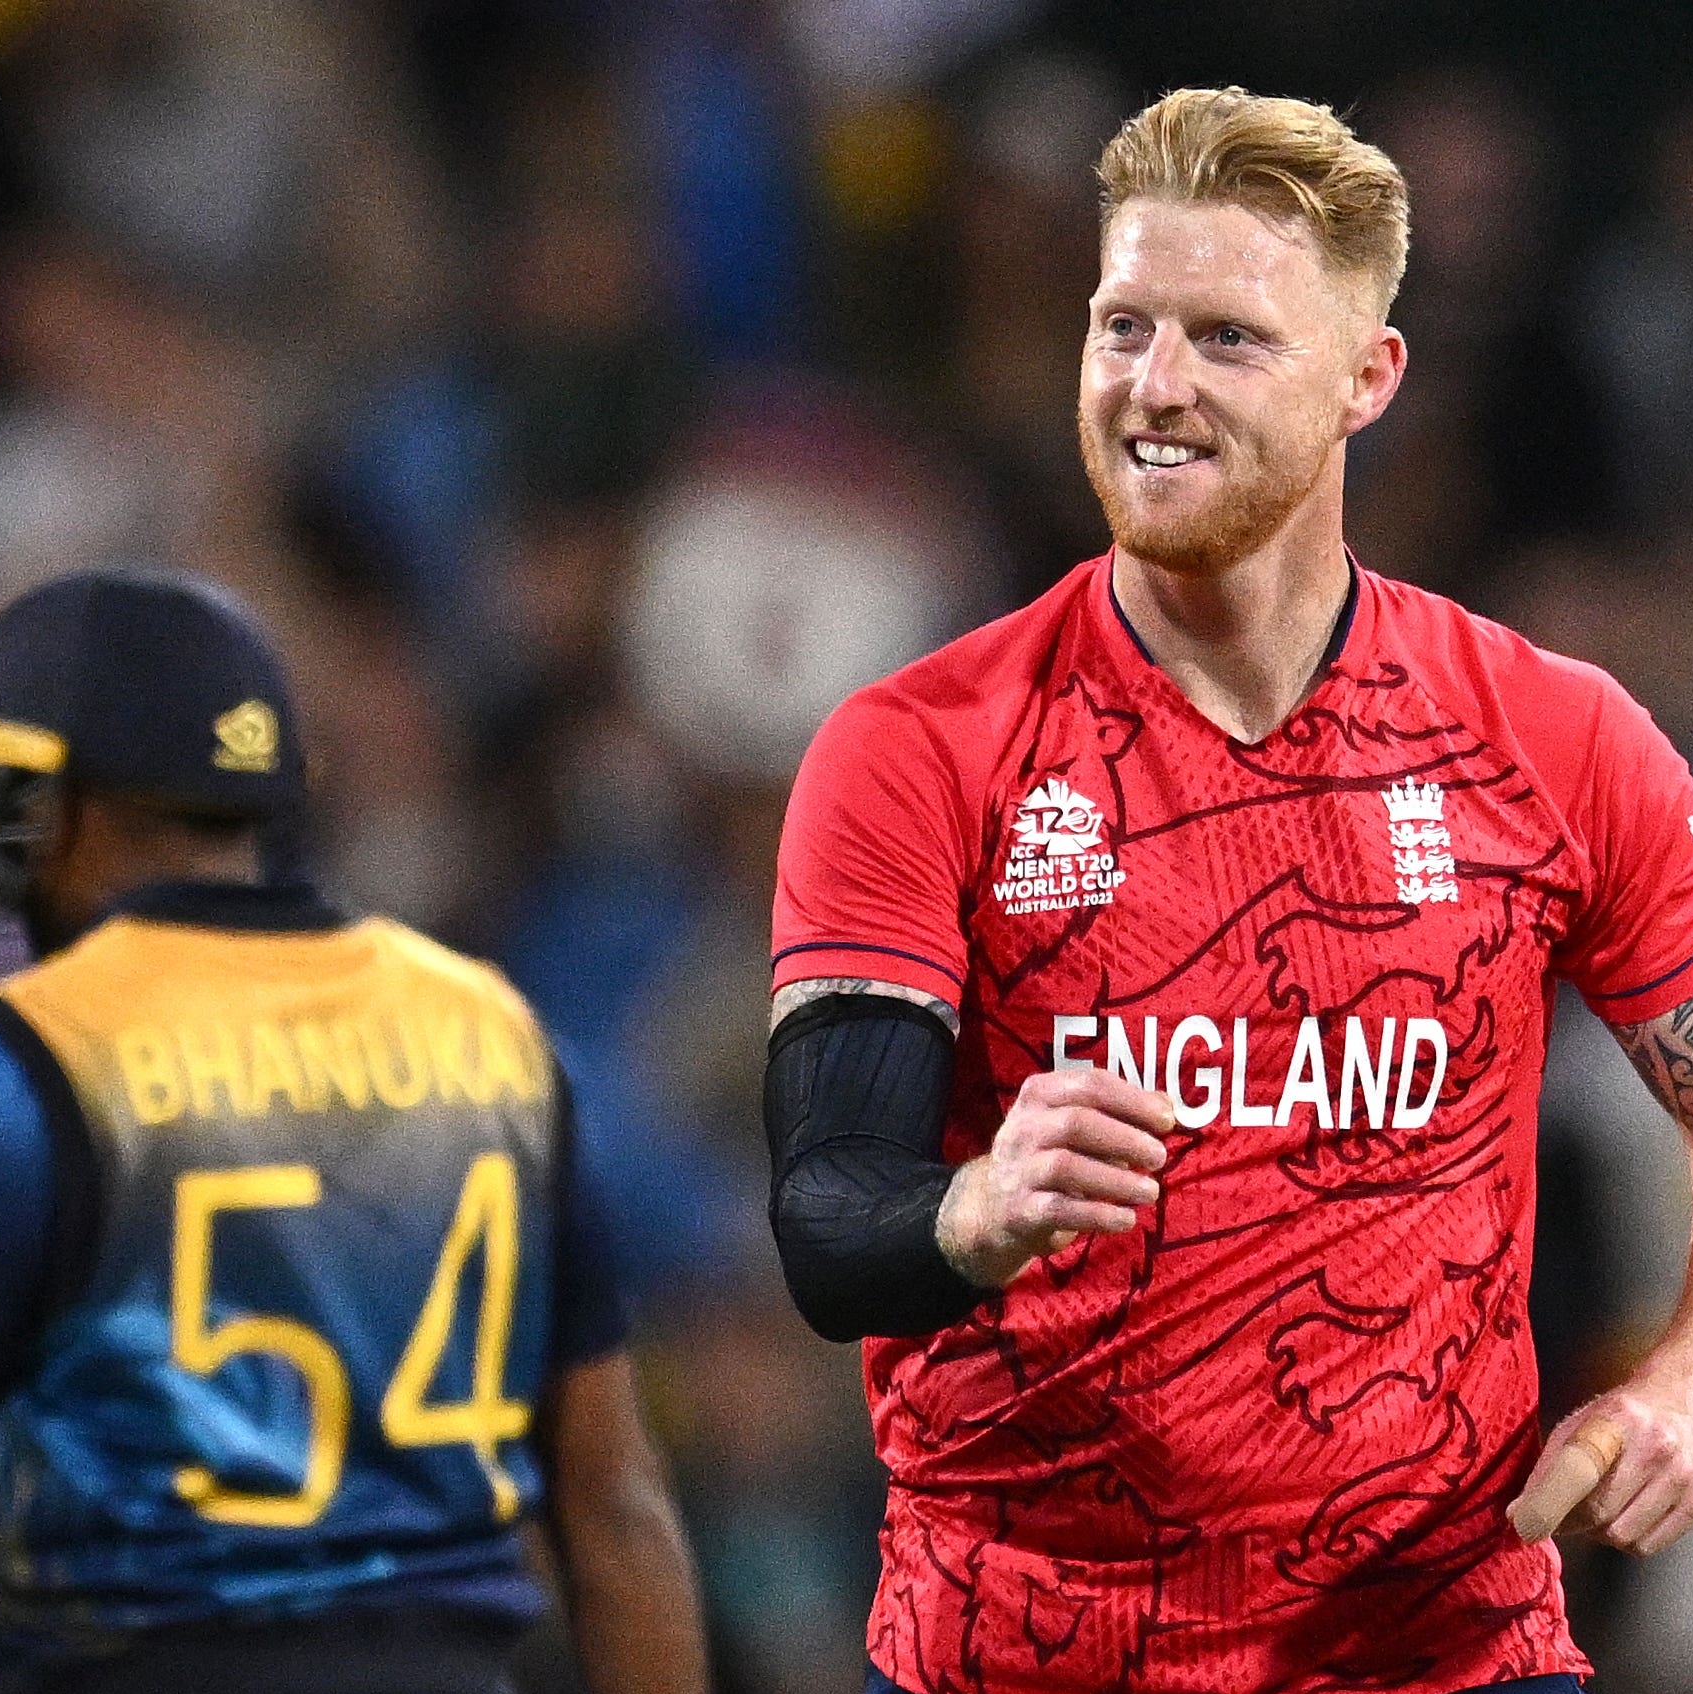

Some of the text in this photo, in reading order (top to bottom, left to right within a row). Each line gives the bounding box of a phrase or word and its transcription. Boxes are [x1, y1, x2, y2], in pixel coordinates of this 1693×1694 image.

[1005, 854, 1114, 880] MEN'S T20
[1010, 845, 1036, 860] ICC
[993, 871, 1126, 901] WORLD CUP
[1005, 892, 1114, 915] AUSTRALIA 2022
[118, 1010, 543, 1125] BHANUKA
[1053, 1014, 1448, 1130] ENGLAND
[172, 1152, 533, 1528] 54
